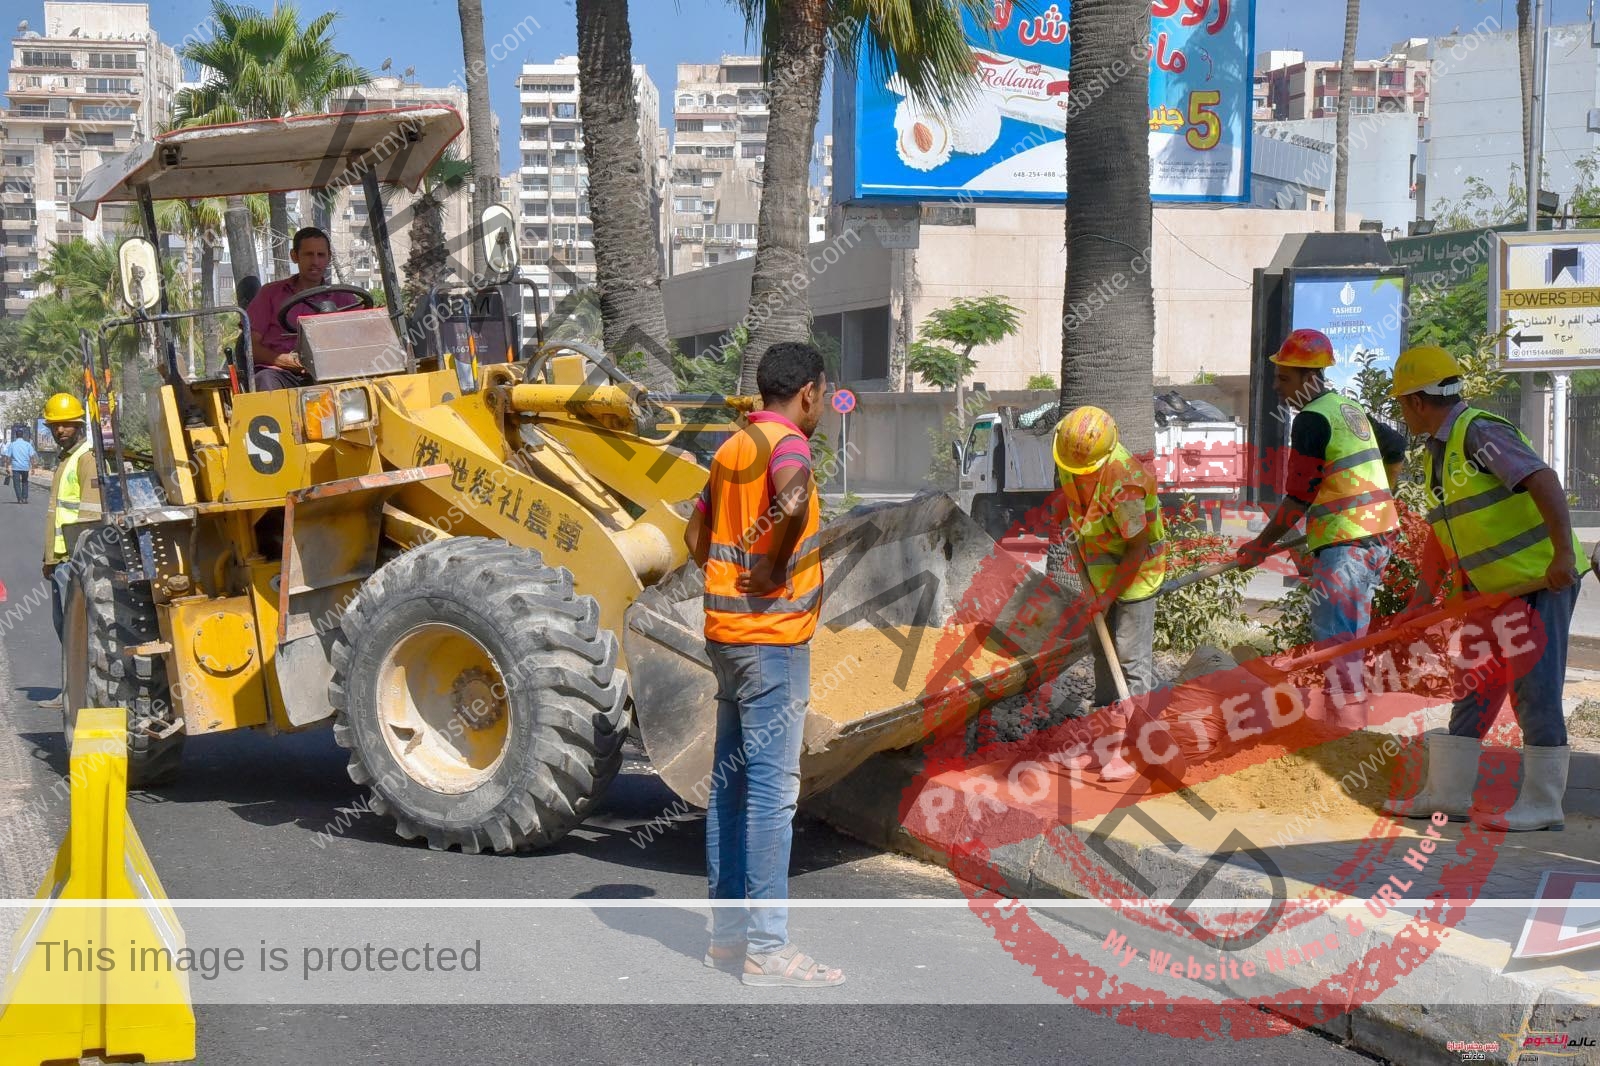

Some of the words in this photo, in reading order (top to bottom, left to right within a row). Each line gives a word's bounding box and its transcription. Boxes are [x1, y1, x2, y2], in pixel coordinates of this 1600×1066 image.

[981, 67, 1046, 90] Rollana
[1505, 292, 1567, 306] TOWERS
[1331, 306, 1362, 314] TASHEED
[247, 415, 285, 475] S
